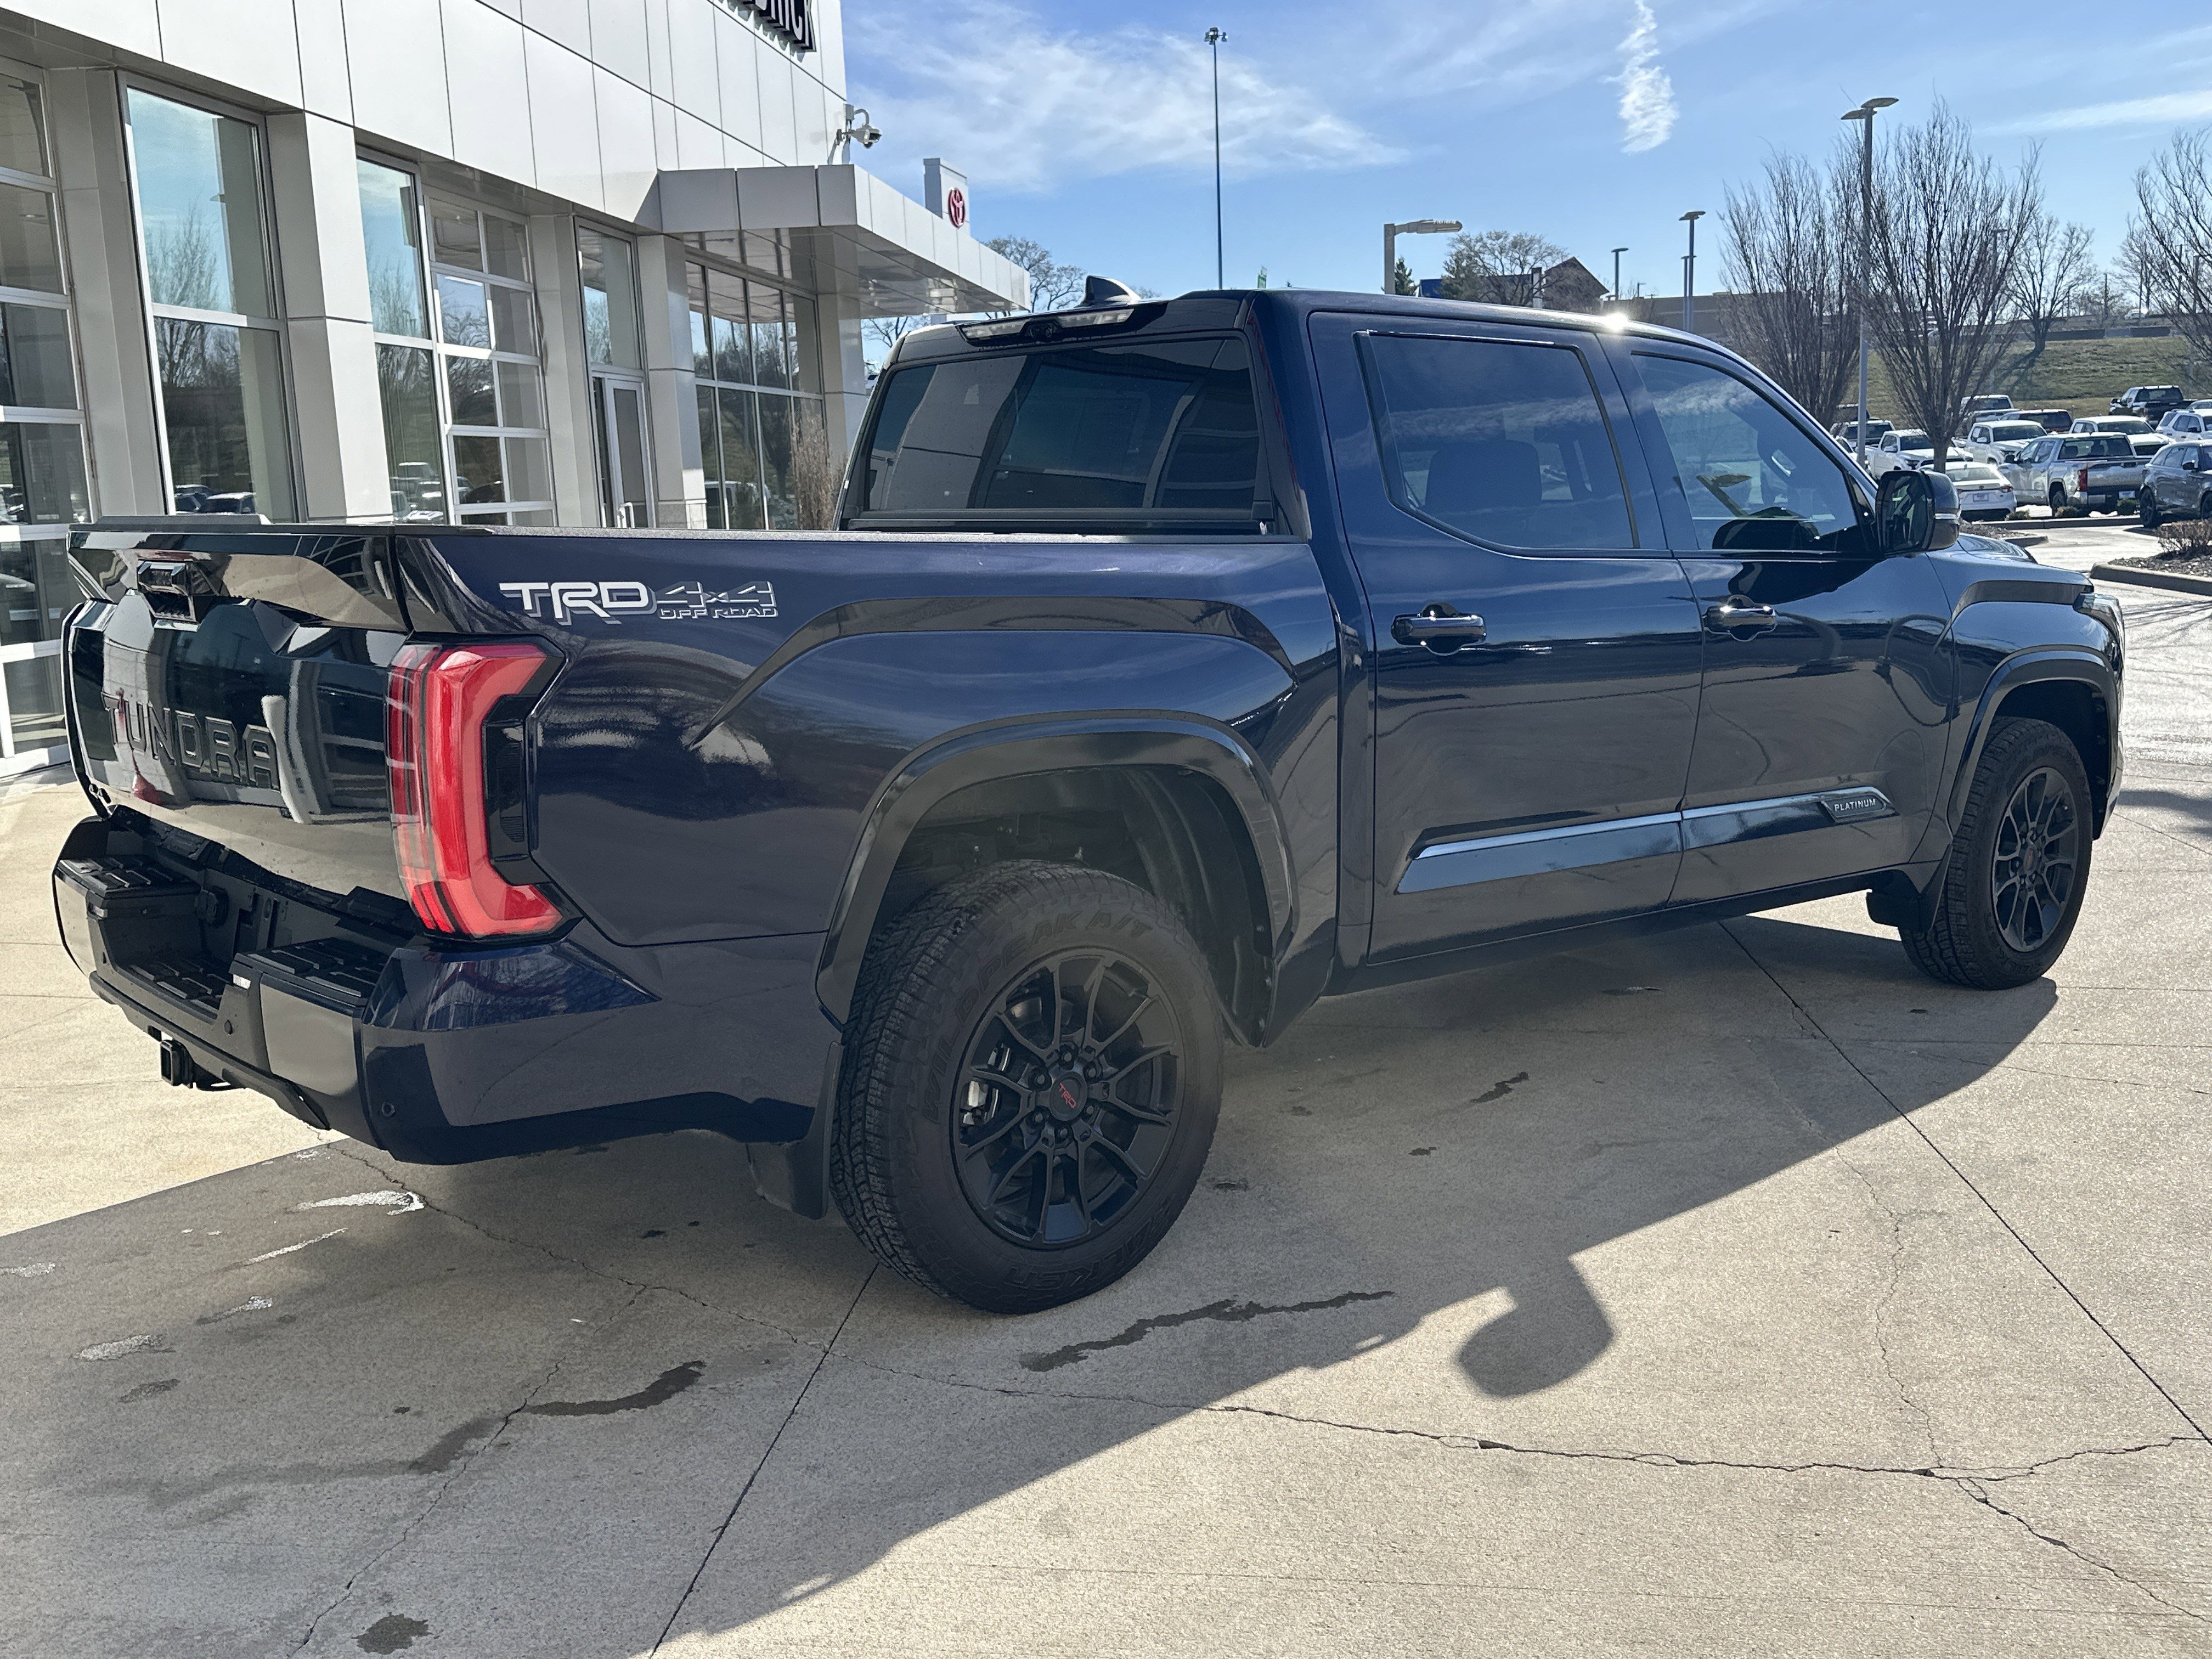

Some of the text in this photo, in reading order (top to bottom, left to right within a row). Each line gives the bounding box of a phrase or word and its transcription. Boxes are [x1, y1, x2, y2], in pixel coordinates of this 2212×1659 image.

[499, 582, 657, 625] TRD
[659, 607, 778, 620] OFF ROAD
[101, 691, 280, 791] TUNDRA
[1834, 798, 1876, 812] PLATINUM
[923, 910, 1153, 1124] WILDPEAK A/T
[1059, 1082, 1077, 1109] TRD
